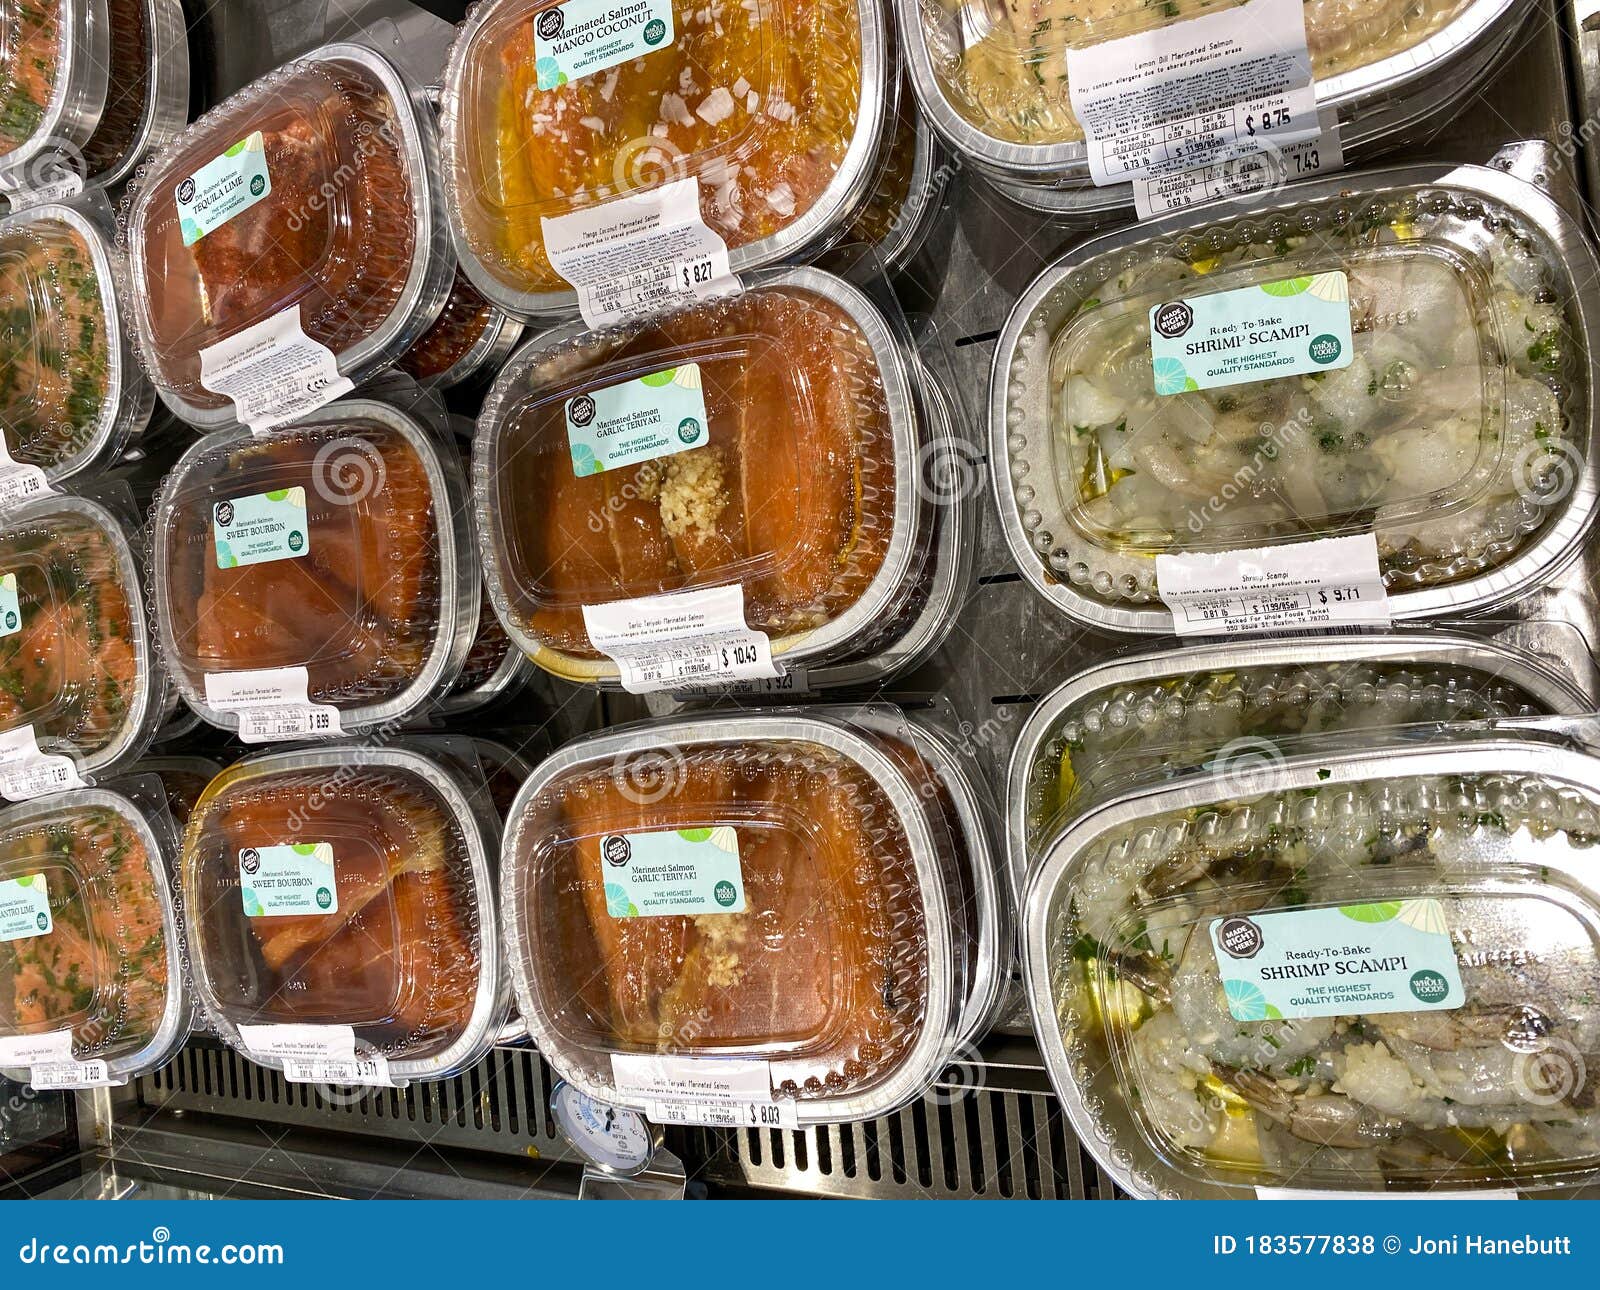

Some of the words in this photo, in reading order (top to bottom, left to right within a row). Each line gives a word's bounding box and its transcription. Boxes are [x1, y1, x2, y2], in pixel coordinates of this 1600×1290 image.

[556, 14, 606, 42] Marinated
[608, 0, 647, 21] Salmon
[552, 32, 594, 56] MANGO
[596, 10, 653, 39] COCONUT
[573, 56, 598, 69] QUALITY
[599, 42, 635, 60] STANDARDS
[584, 48, 595, 58] THE
[596, 40, 622, 54] HIGHEST
[1135, 60, 1156, 70] Lemon
[1158, 55, 1168, 64] Dill
[1172, 44, 1206, 61] Marinated
[1210, 40, 1233, 50] Salmon
[1246, 114, 1255, 136] $
[1262, 108, 1291, 130] 8.75
[1116, 136, 1139, 145] Packed
[1199, 132, 1214, 141] Price
[1143, 157, 1150, 166] lb
[1293, 150, 1320, 172] 7.43
[193, 189, 225, 215] TEQUILA
[224, 176, 244, 194] LIME
[682, 267, 690, 288] $
[694, 262, 712, 283] 8.27
[1160, 312, 1188, 330] RIGHT
[1162, 308, 1181, 321] MADE
[1168, 320, 1185, 332] HERE
[1186, 335, 1245, 356] SHRIMP
[1249, 324, 1310, 345] SCAMPI
[1312, 341, 1337, 351] WHOLE
[1222, 358, 1239, 366] THE
[1240, 351, 1277, 364] HIGHEST
[1314, 348, 1337, 357] FOODS
[1207, 365, 1242, 377] QUALITY
[1244, 357, 1295, 371] STANDARDS
[596, 415, 631, 430] Marinated
[632, 408, 659, 420] Salmon
[597, 424, 625, 438] GARLIC
[626, 415, 661, 430] TERIYAKI
[631, 434, 656, 445] HIGHEST
[608, 448, 633, 459] QUALITY
[634, 438, 669, 453] STANDARDS
[226, 529, 249, 540] SWEET
[251, 522, 286, 535] BOURBON
[1266, 572, 1289, 581] Scampi
[1318, 590, 1327, 605] $
[1334, 588, 1360, 601] 9.71
[722, 648, 728, 668] $
[733, 645, 757, 665] 10.43
[316, 714, 329, 729] 8.99
[608, 845, 626, 858] RIGHT
[632, 864, 667, 874] Marinated
[668, 864, 695, 872] Salmon
[632, 873, 660, 882] GARLIC
[661, 872, 697, 881] TERIYAKI
[252, 880, 275, 888] SWEET
[277, 878, 313, 887] BOURBON
[1225, 925, 1248, 939] MADE
[1225, 930, 1255, 948] RIGHT
[1234, 939, 1255, 952] HERE
[1285, 945, 1371, 961] Ready-To-Bake
[1260, 963, 1331, 981] SHRIMP
[1334, 956, 1408, 975] SCAMPI
[1305, 986, 1327, 995] THE
[1328, 984, 1372, 994] HIGHEST
[1412, 978, 1444, 988] WHOLE
[1416, 985, 1445, 994] FOODS
[1290, 996, 1332, 1006] QUALITY
[1334, 991, 1395, 1004] STANDARDS
[750, 1103, 757, 1123] $
[761, 1105, 780, 1124] 8.03
